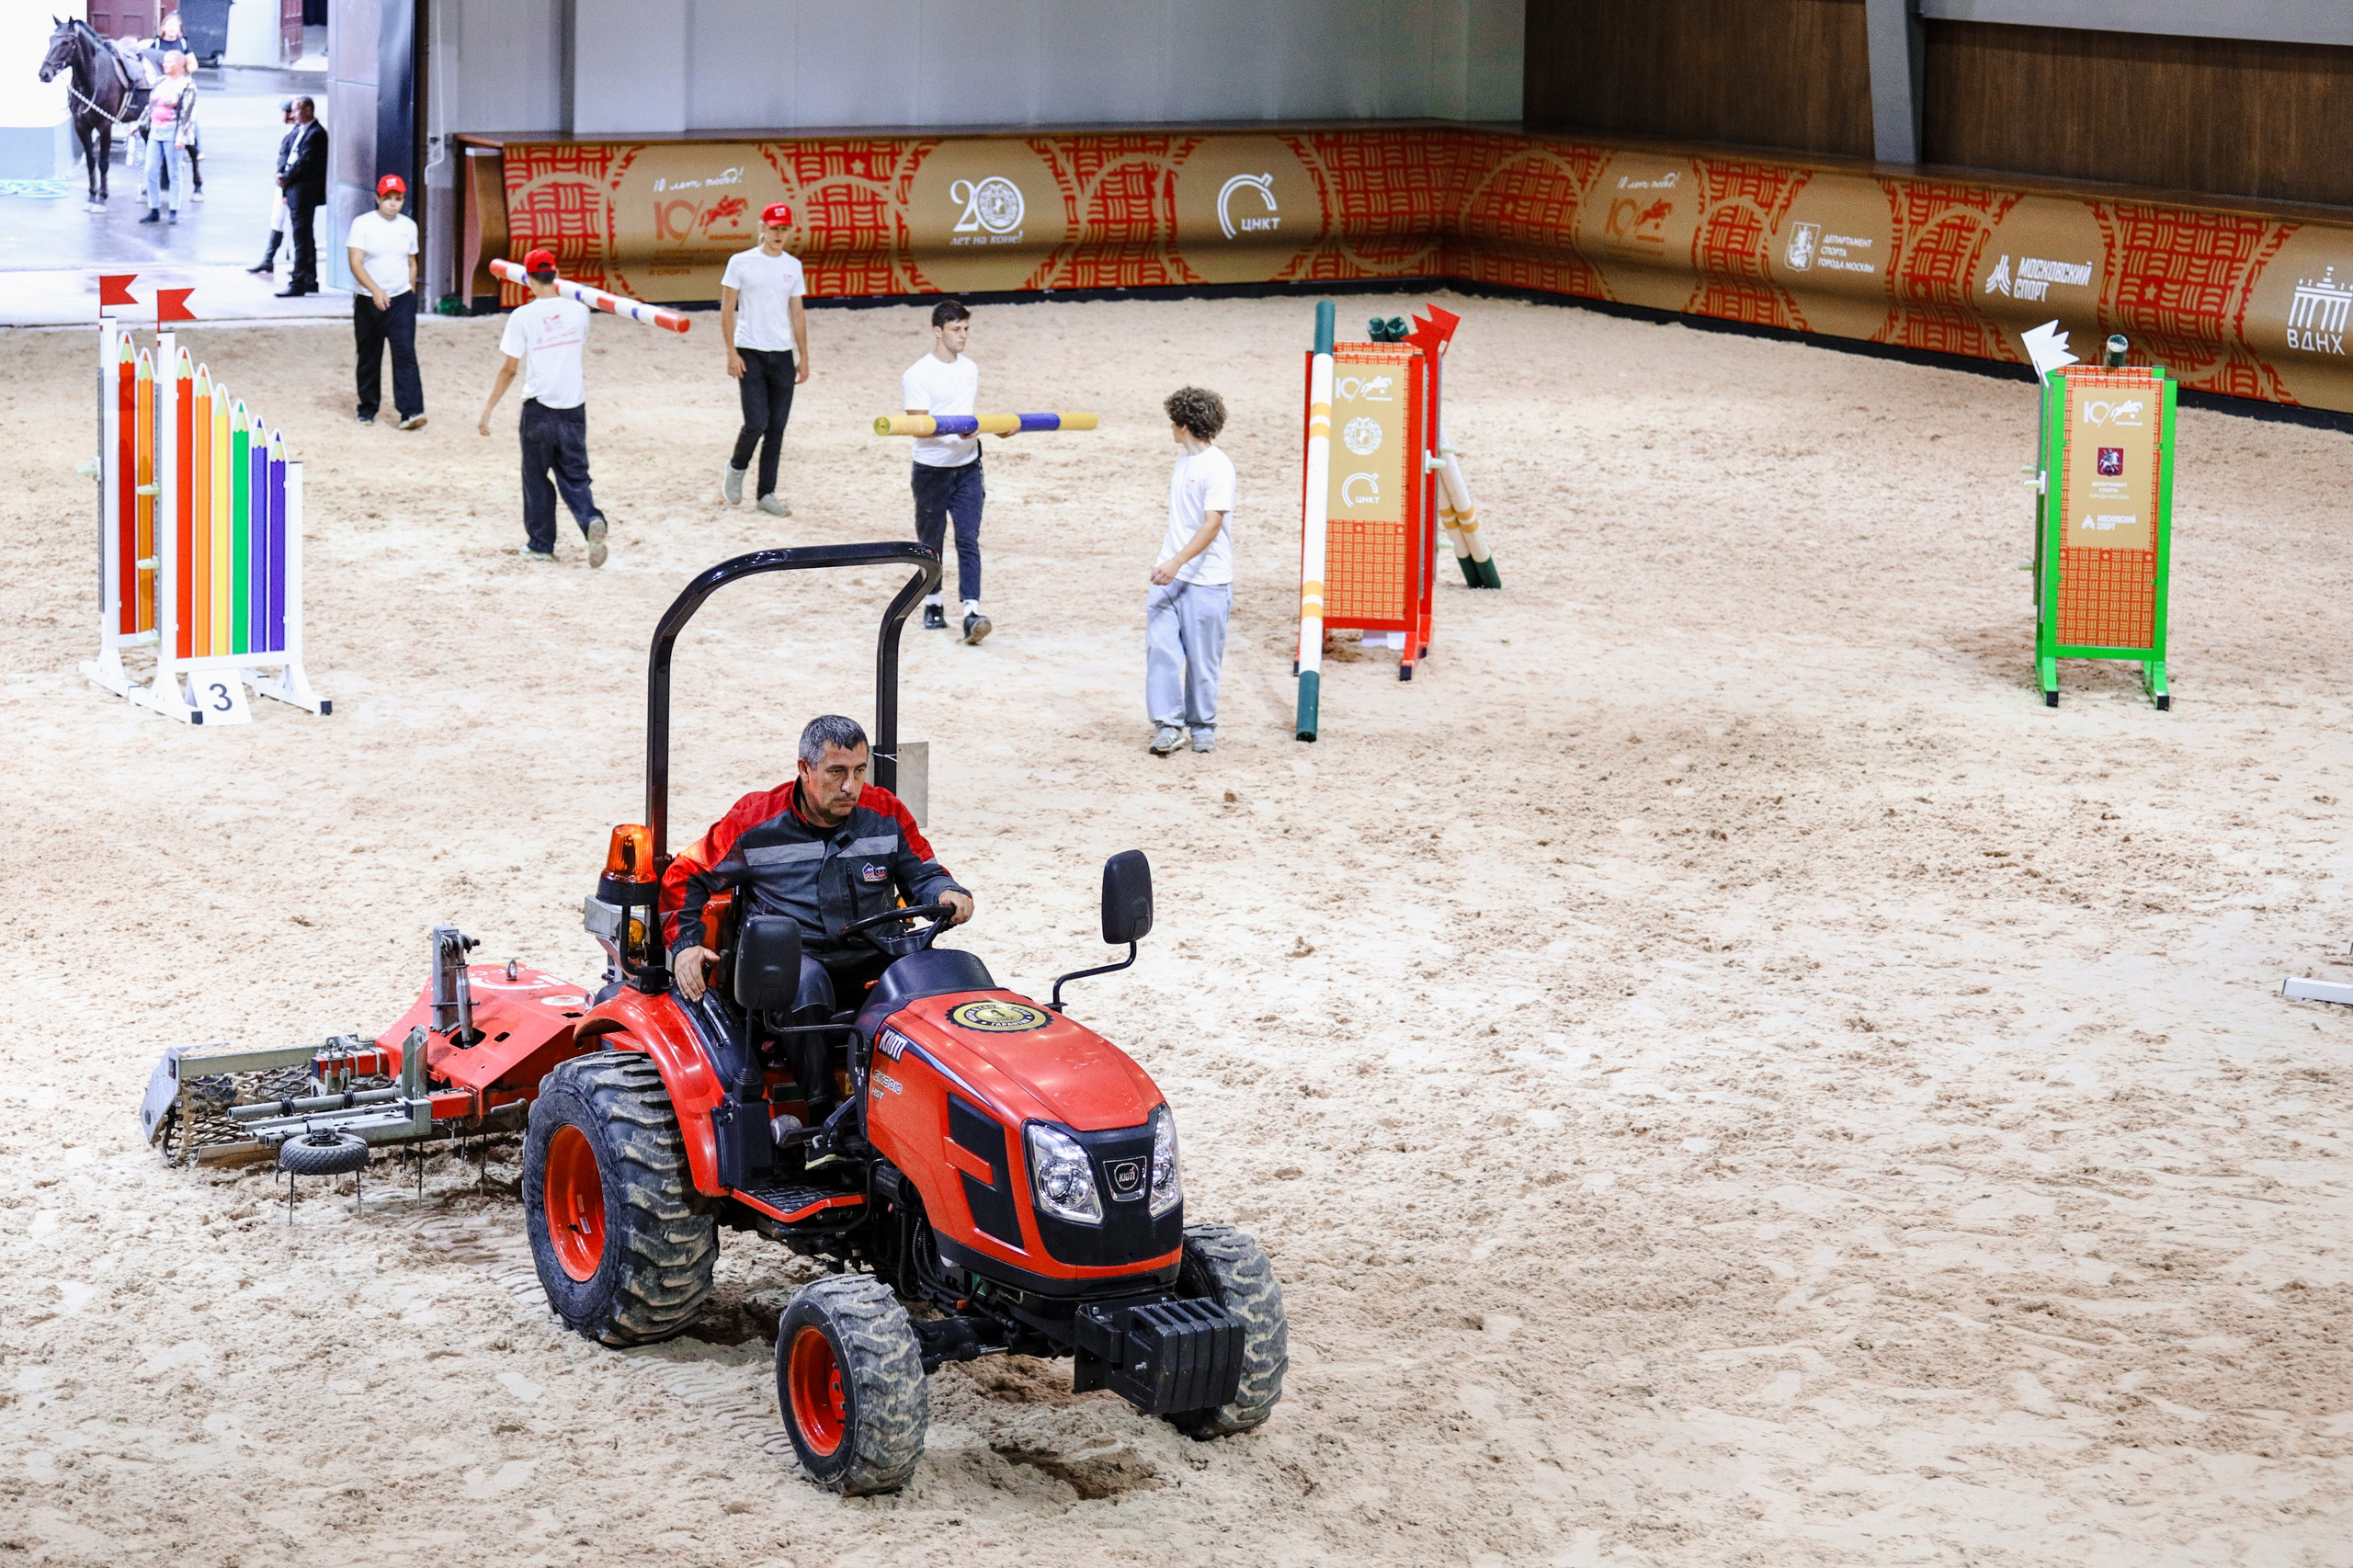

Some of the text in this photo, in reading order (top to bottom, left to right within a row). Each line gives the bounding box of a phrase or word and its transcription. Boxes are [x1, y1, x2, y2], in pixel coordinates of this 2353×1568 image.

[949, 176, 1025, 234] 20
[1241, 217, 1281, 232] ЦНКТ
[1823, 233, 1874, 248] ДЕПАРТАМЕНТ
[1821, 245, 1847, 257] СПОРТА
[1817, 257, 1876, 274] ГОРОДА МОСКВЫ
[2018, 257, 2093, 287] МОСКОВСКИЙ
[2013, 278, 2050, 302] СПОРТ
[2287, 328, 2346, 356] ВДНХ
[1355, 495, 1381, 505] ЦНКТ
[209, 683, 233, 711] 3
[878, 1028, 908, 1061] KIOTI
[871, 1086, 884, 1099] HST
